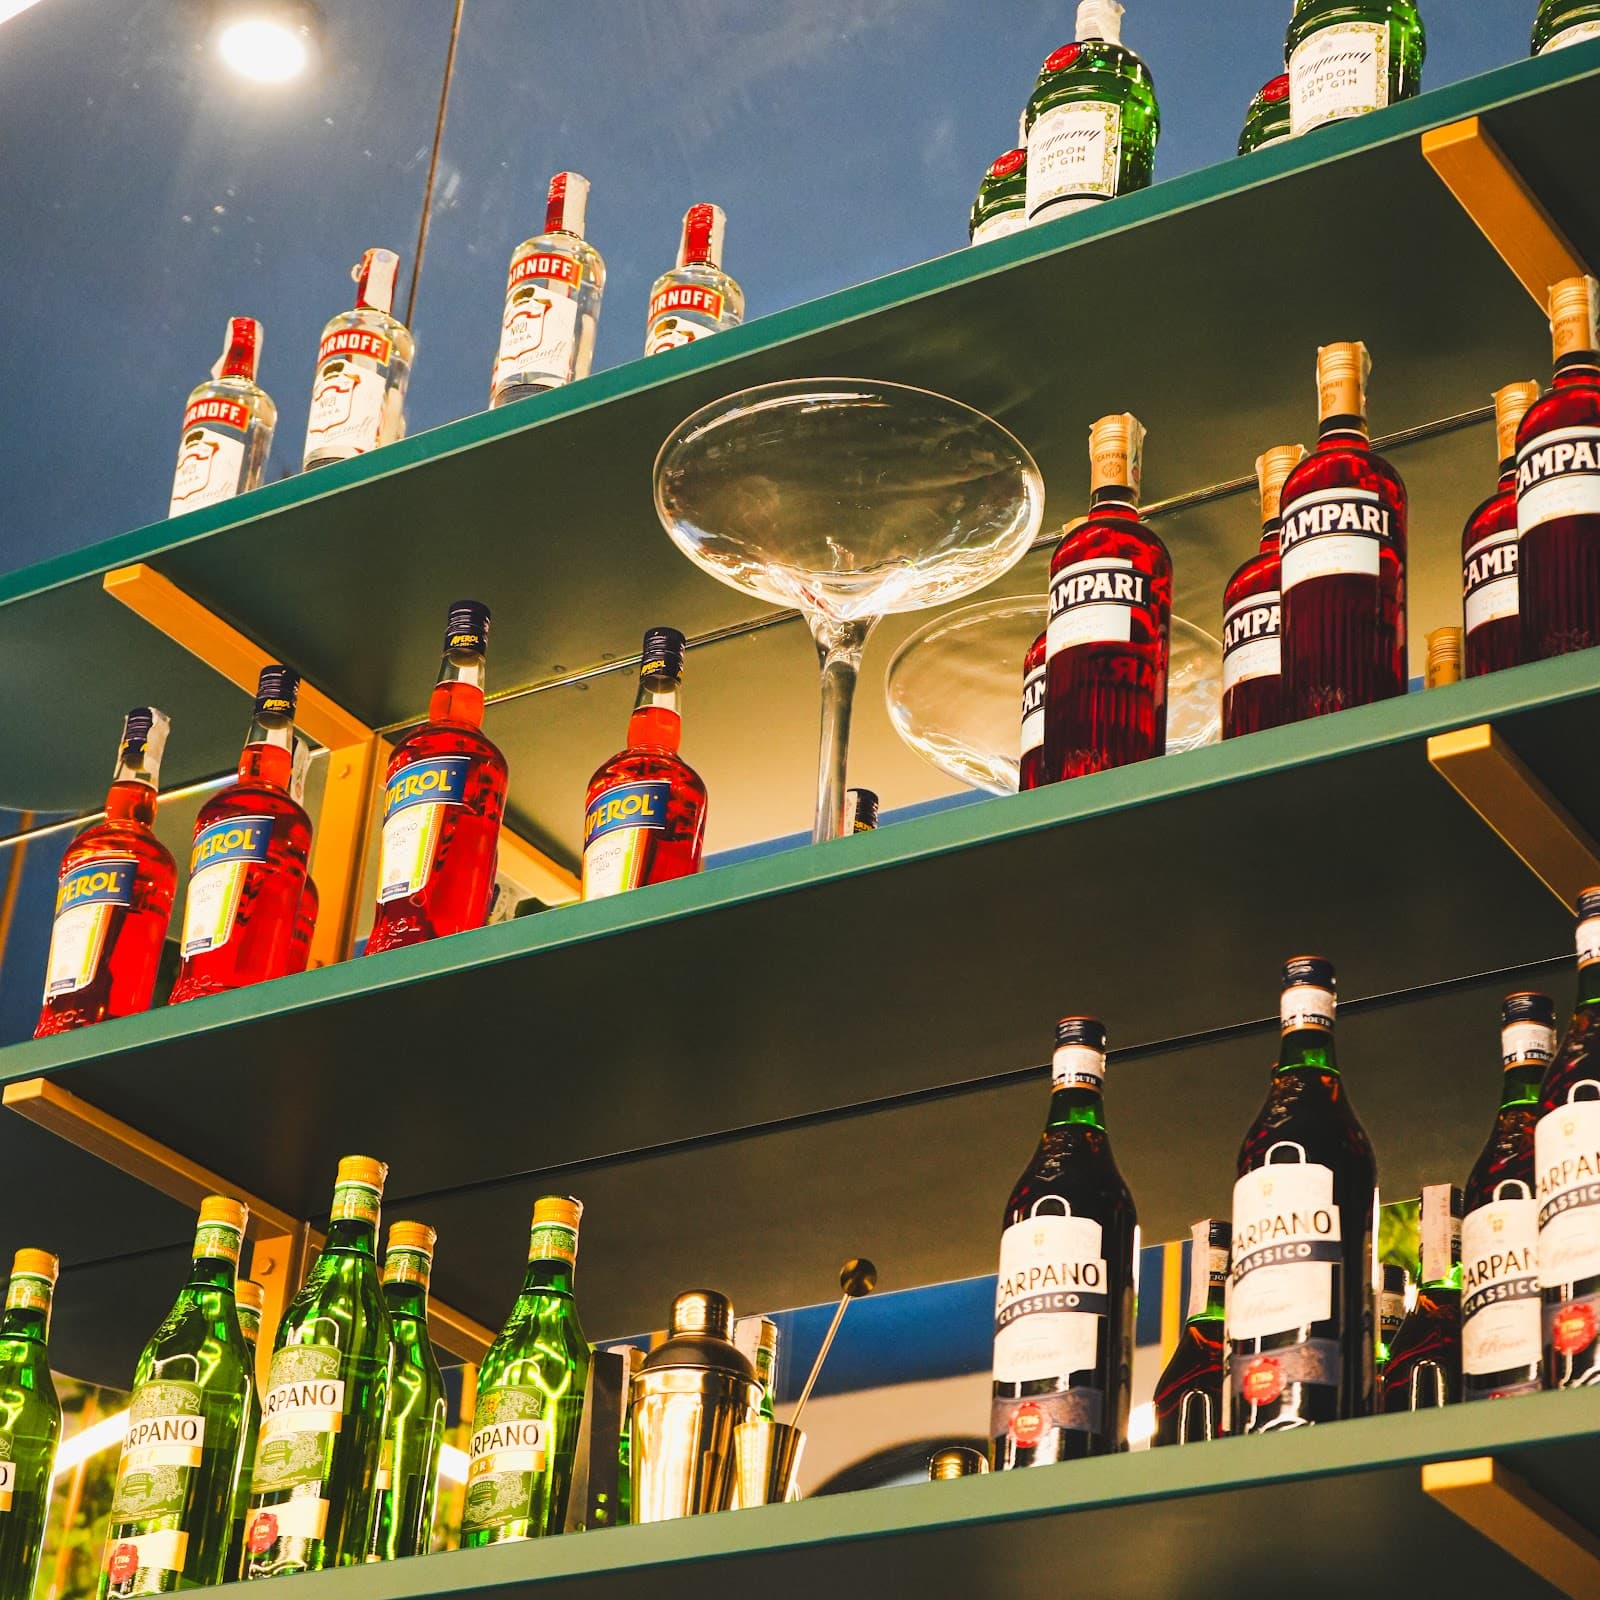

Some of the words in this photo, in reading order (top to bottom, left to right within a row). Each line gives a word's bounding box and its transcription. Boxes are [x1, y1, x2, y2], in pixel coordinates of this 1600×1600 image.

[1330, 79, 1357, 88] GIN
[1060, 155, 1085, 165] GIN
[507, 258, 572, 287] IRNOFF
[649, 290, 713, 318] IRNOFF
[320, 334, 382, 358] IRNOFF
[188, 402, 240, 423] RNOFF
[1515, 442, 1600, 502] AMPA
[1047, 573, 1144, 622] AMPARI
[1223, 605, 1280, 654] AMPA
[1536, 1152, 1600, 1196] ARPA
[999, 1294, 1081, 1325] CLASSICO
